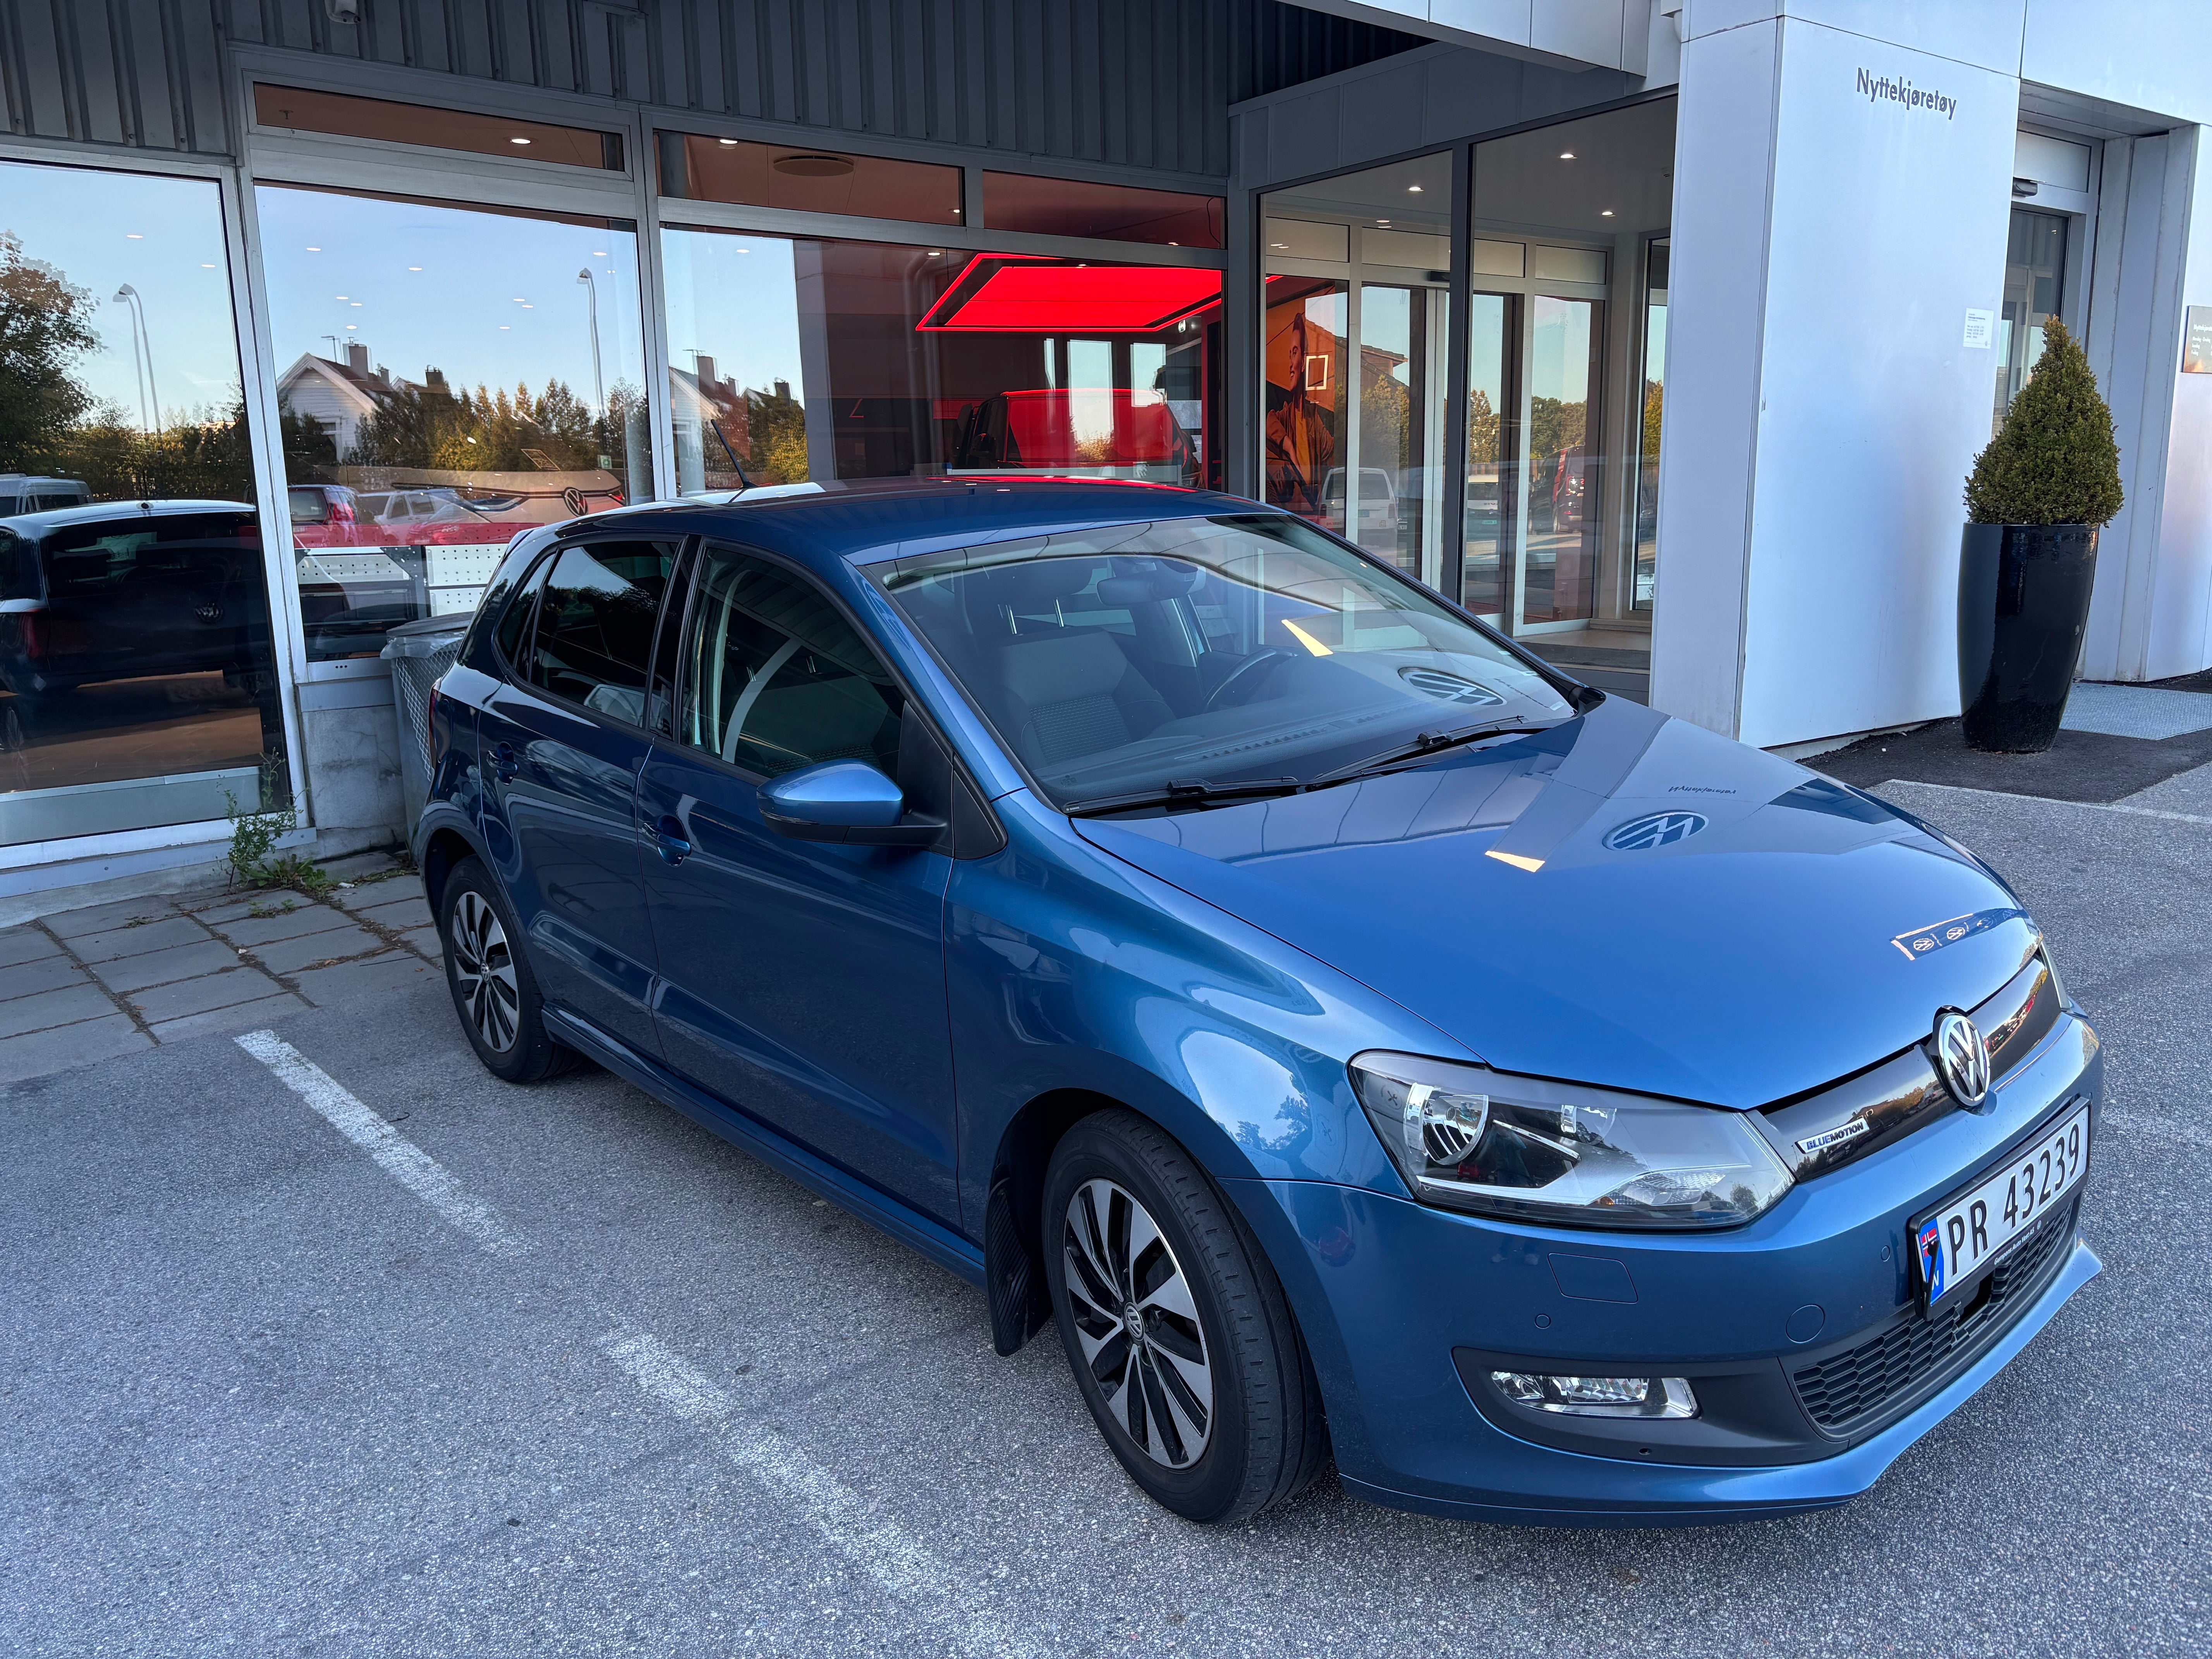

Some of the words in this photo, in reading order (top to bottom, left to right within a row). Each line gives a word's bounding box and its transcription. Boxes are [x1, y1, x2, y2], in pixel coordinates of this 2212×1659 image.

[1857, 67, 1957, 120] Nyttekjøretøy
[1807, 1121, 1864, 1150] BLUEMOTION
[1947, 1199, 1988, 1276] PR
[2003, 1123, 2080, 1229] 43239
[2012, 1240, 2021, 1251] Auto
[2021, 1232, 2030, 1243] Vest
[2029, 1227, 2035, 1236] AS
